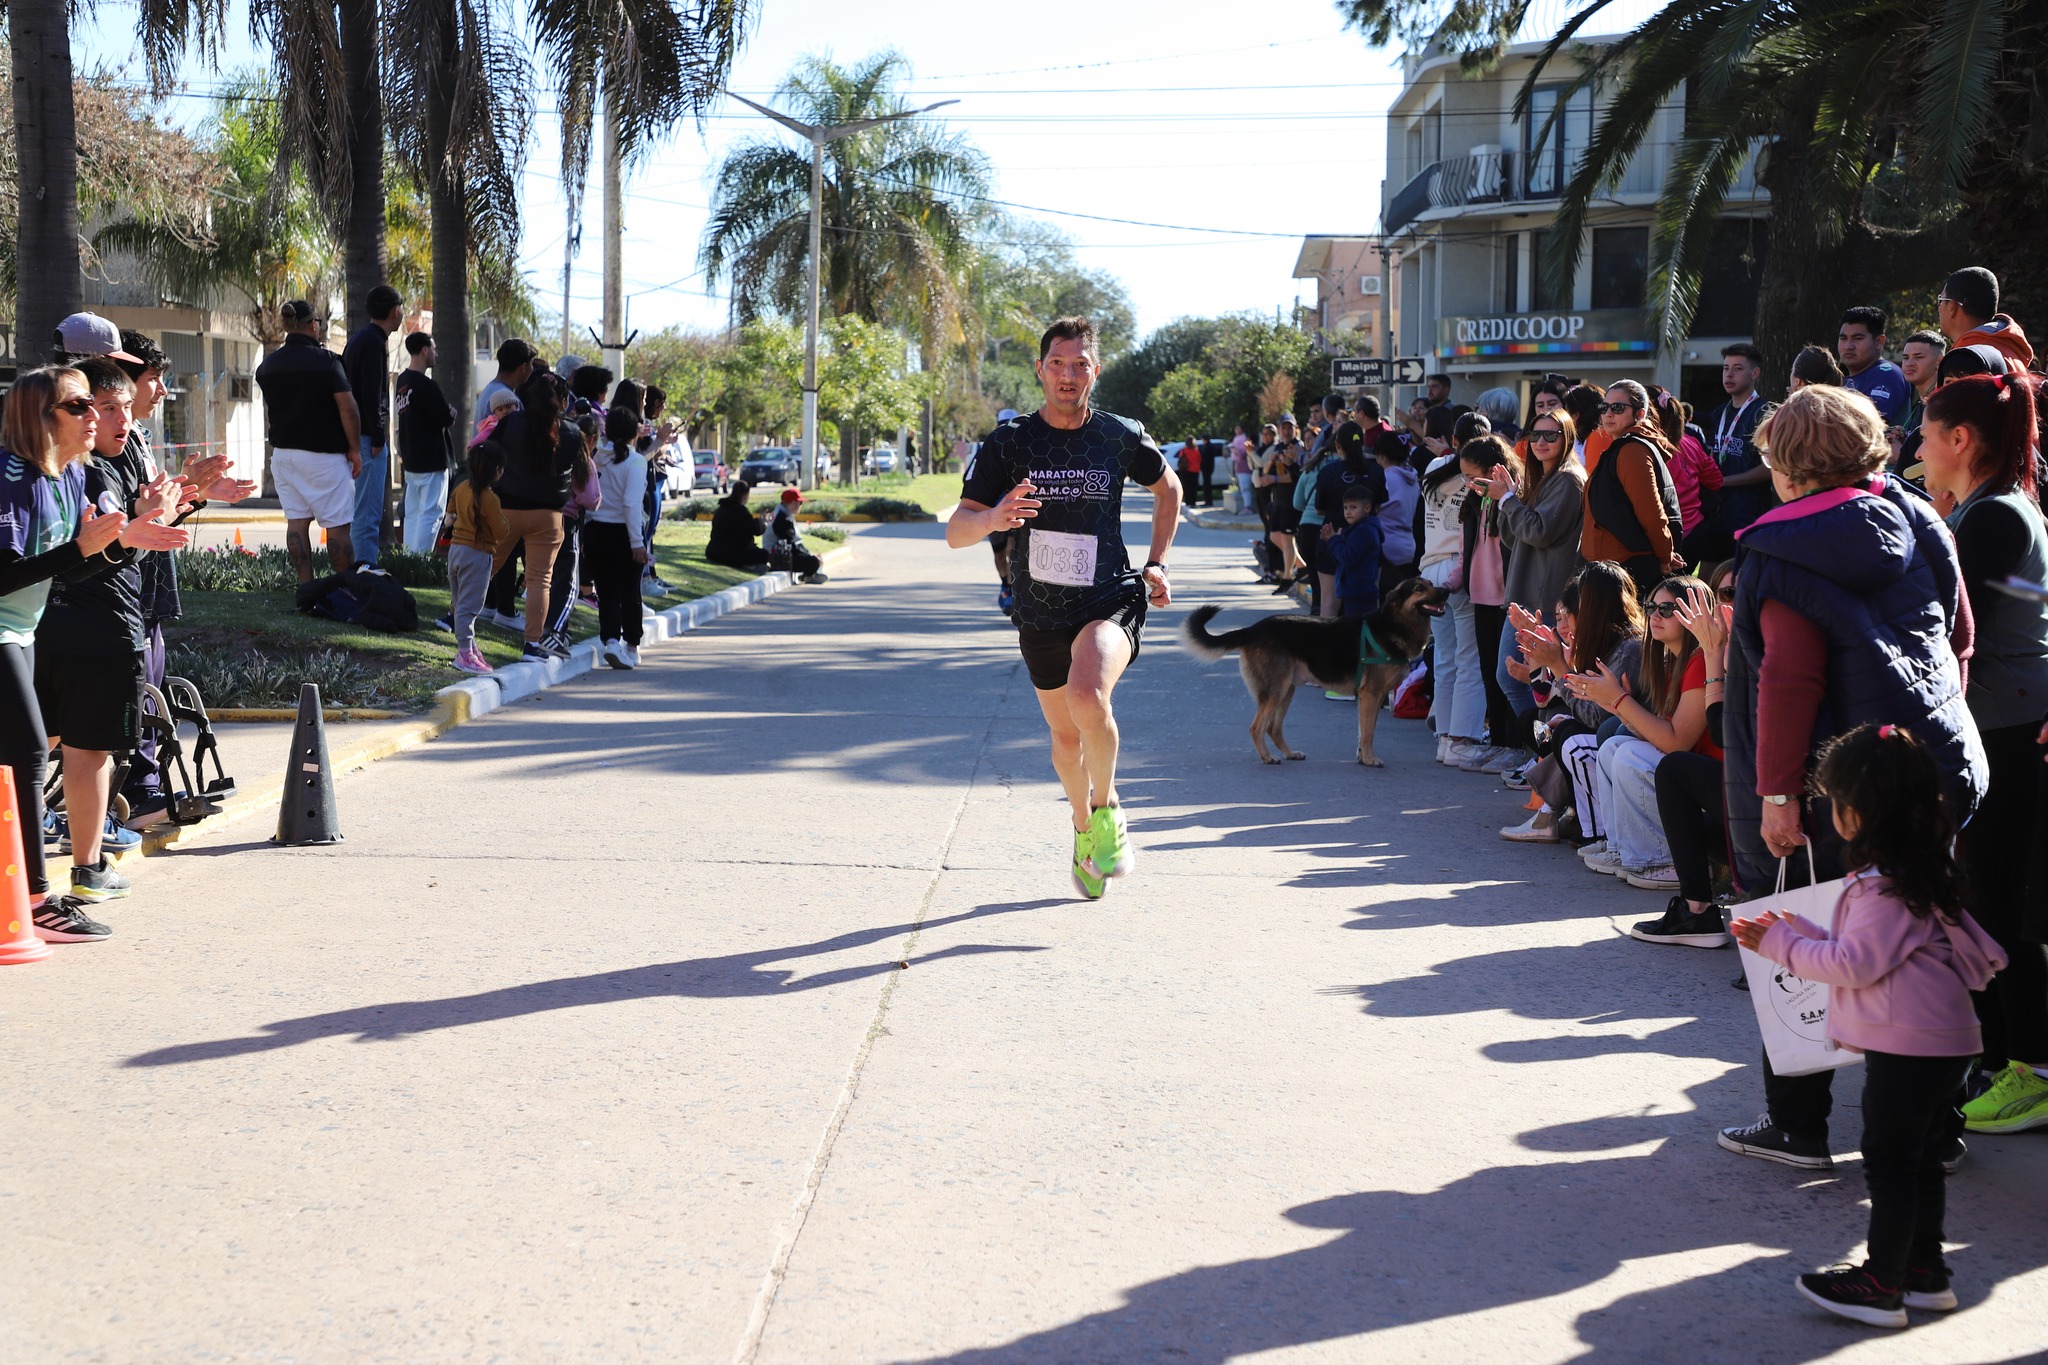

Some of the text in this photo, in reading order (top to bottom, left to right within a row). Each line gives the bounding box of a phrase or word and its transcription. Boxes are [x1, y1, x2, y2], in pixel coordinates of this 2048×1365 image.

[1456, 316, 1584, 342] CREDICOOP
[1338, 376, 1357, 385] 2200
[1363, 375, 1382, 384] 2300
[1029, 469, 1085, 479] MARATON
[1083, 469, 1111, 495] 82
[1036, 545, 1088, 574] 033
